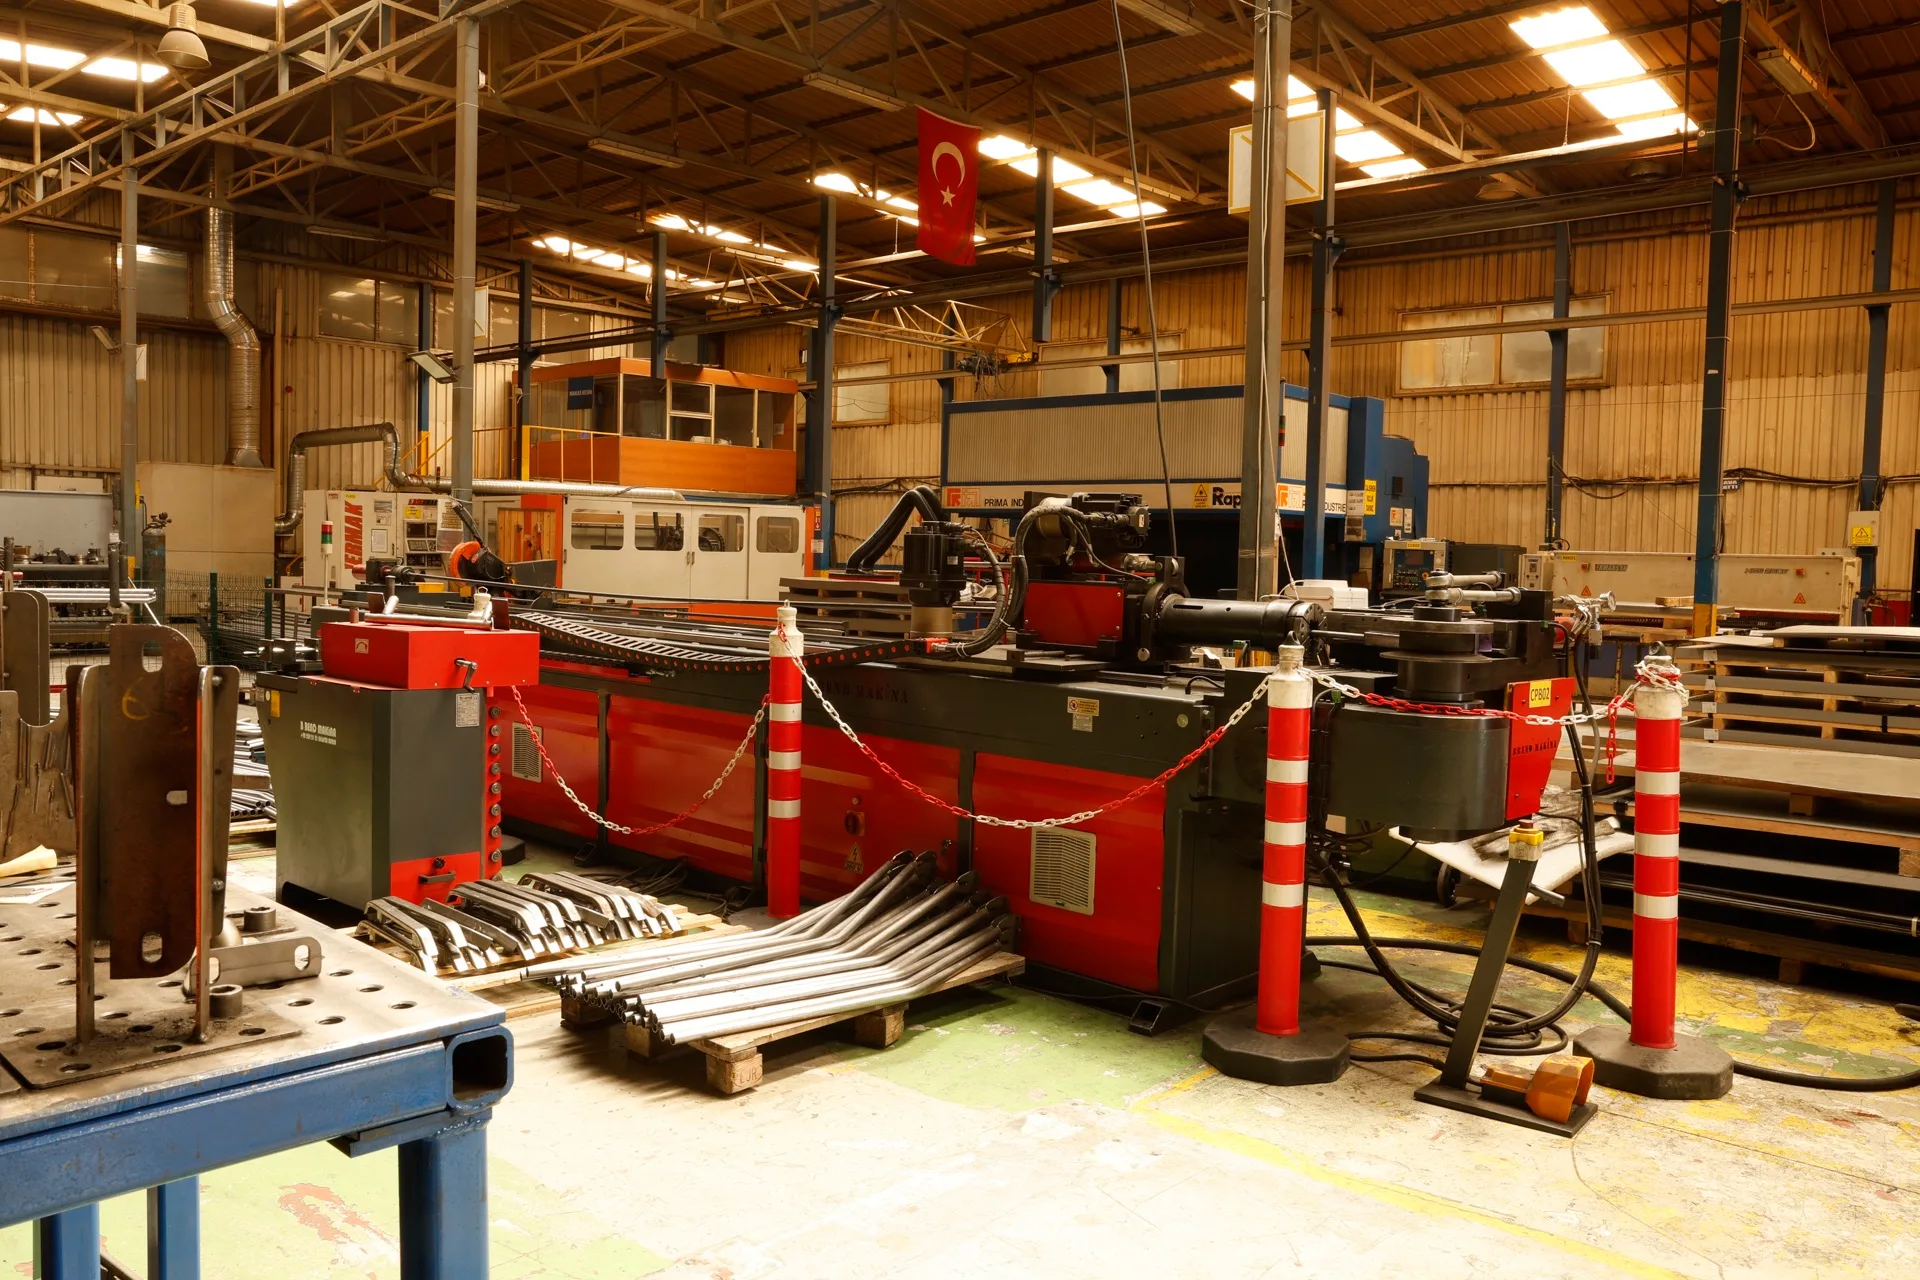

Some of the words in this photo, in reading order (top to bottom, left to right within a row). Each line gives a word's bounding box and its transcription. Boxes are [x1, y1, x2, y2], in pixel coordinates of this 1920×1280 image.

[984, 498, 1008, 507] PRIMA
[1010, 498, 1025, 507] IND
[1212, 486, 1241, 509] Rap
[1324, 501, 1346, 512] DUSTRIE
[1530, 687, 1550, 702] CPB02
